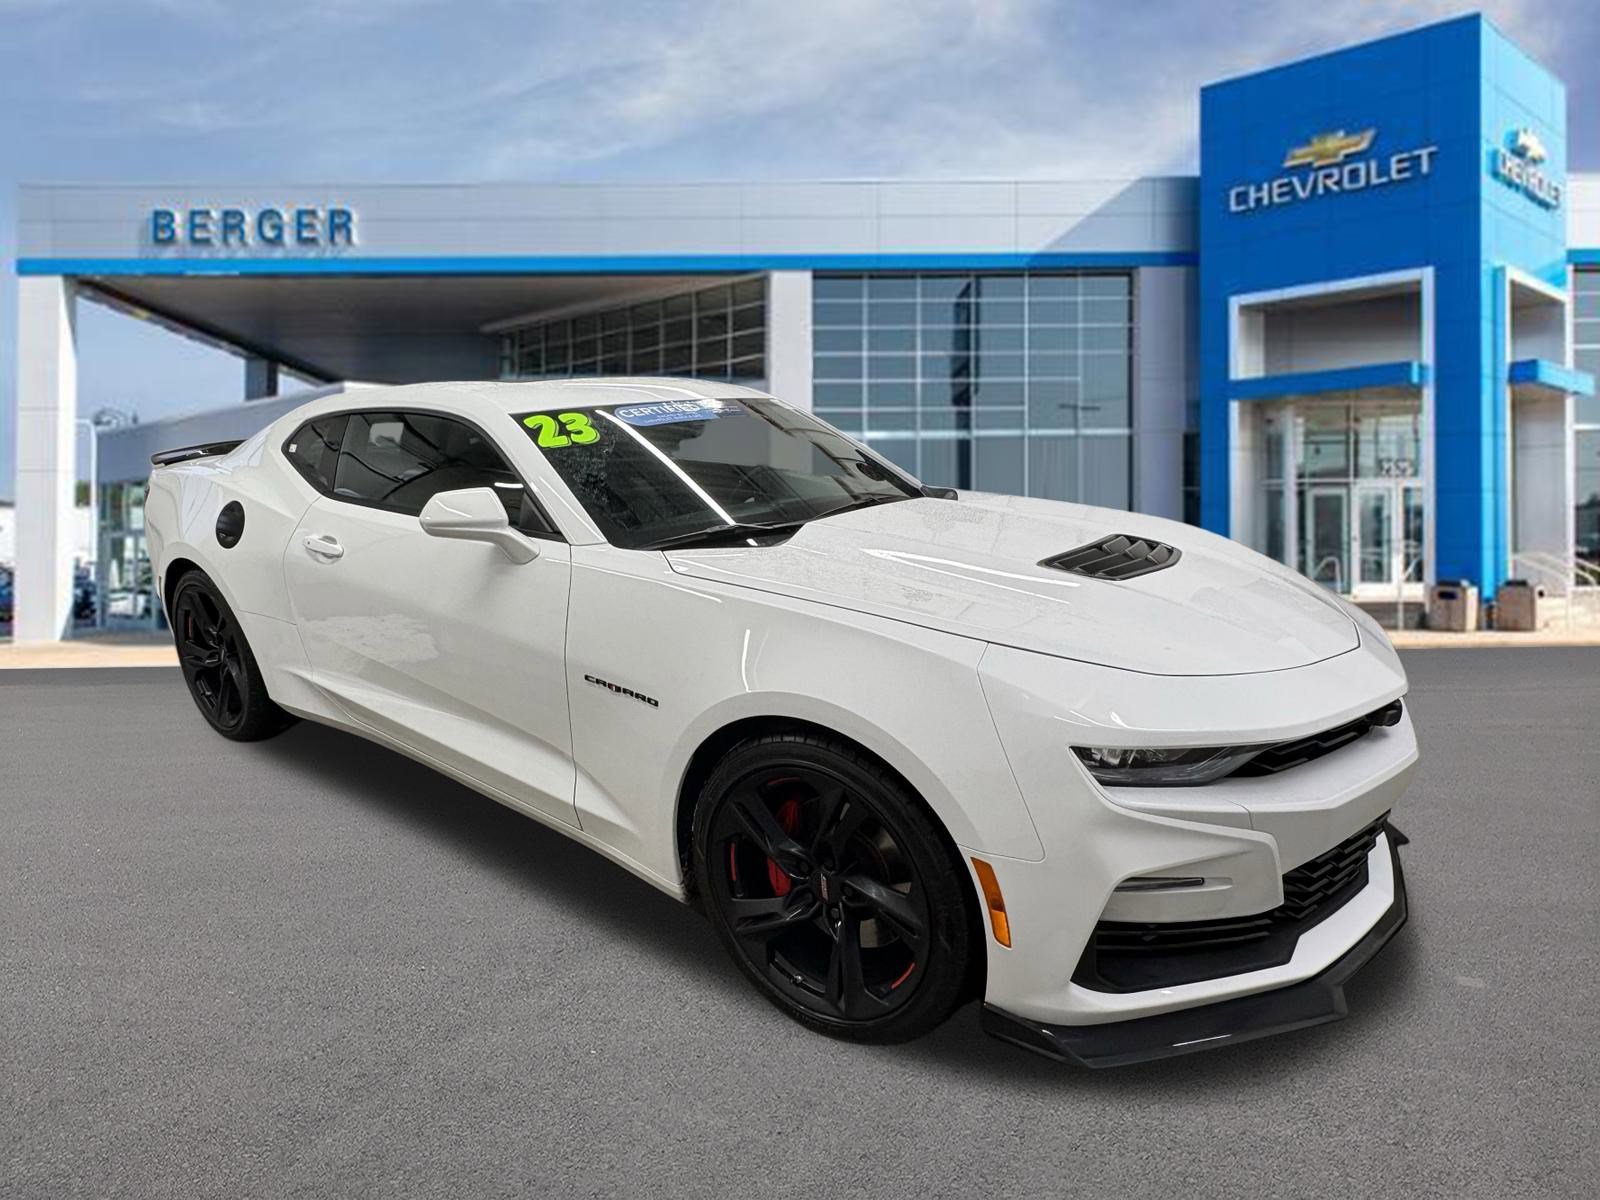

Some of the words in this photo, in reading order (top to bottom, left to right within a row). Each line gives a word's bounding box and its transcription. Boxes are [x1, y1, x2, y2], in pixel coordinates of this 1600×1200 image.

[1229, 146, 1438, 212] CHEVROLET
[152, 208, 355, 246] BERGER
[523, 412, 600, 449] 23
